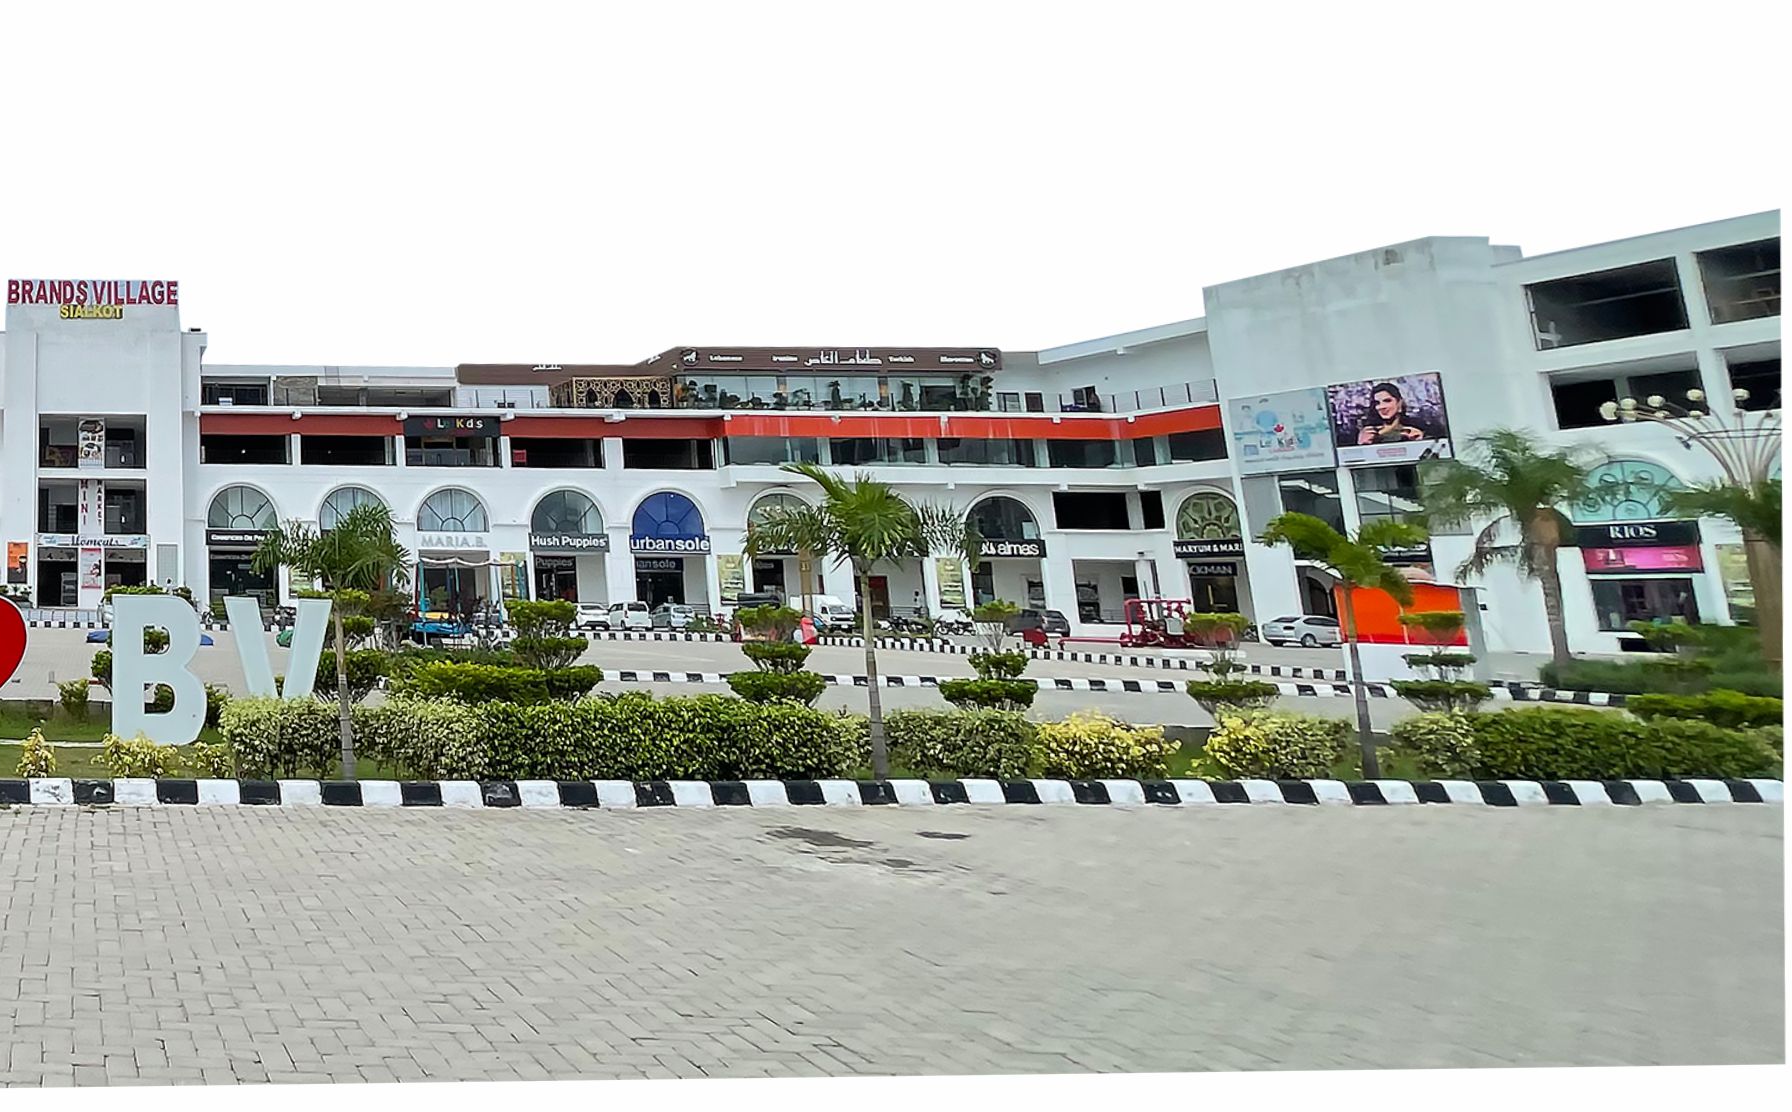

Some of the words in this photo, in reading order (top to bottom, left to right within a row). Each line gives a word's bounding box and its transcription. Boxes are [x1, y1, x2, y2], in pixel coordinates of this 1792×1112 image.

[7, 279, 88, 305] BRANDS
[92, 279, 179, 305] VILLAGE
[60, 304, 123, 319] SIALKOT
[1609, 524, 1657, 539] RIOS
[531, 535, 559, 547] Hush
[561, 535, 606, 551] Puppies
[631, 536, 710, 550] urbansole
[997, 541, 1040, 555] almas
